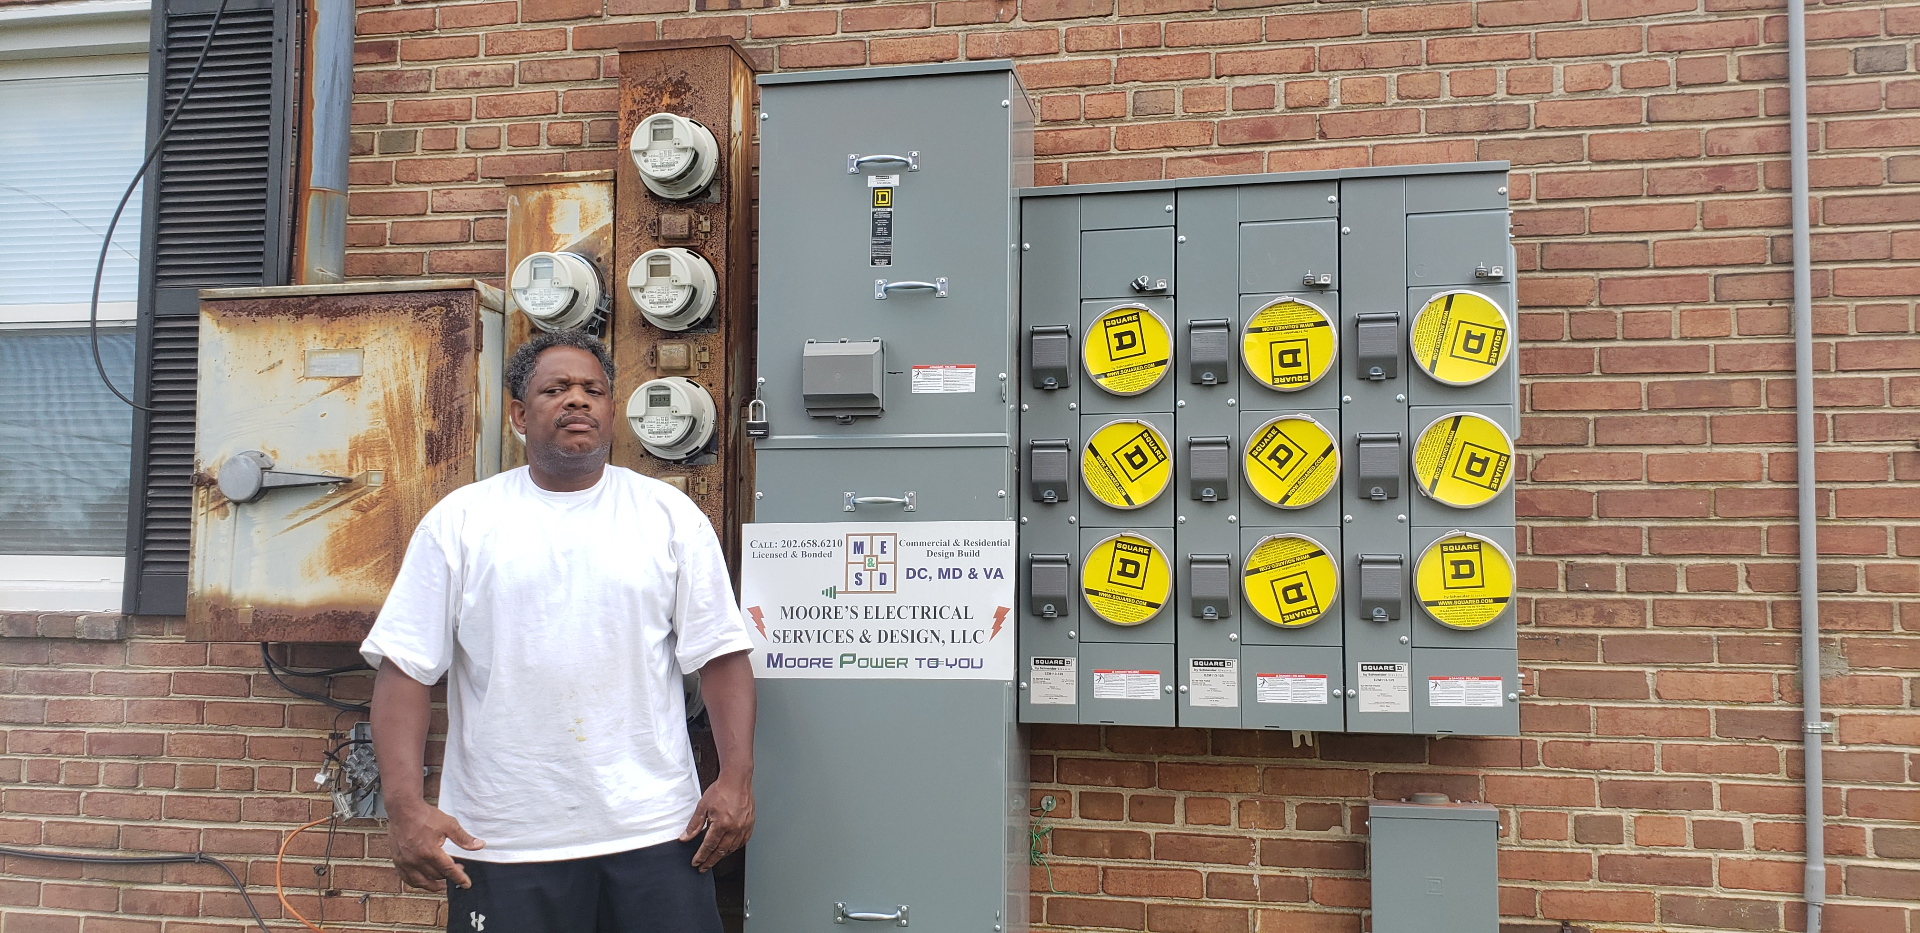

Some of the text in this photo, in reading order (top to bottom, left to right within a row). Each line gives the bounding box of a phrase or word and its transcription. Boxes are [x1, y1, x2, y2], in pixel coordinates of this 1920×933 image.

[877, 192, 888, 203] D
[1105, 315, 1138, 326] SQUARE
[1113, 330, 1137, 351] D
[1463, 330, 1486, 354] D
[1489, 329, 1503, 364] SQUARE
[1278, 348, 1302, 369] D
[1274, 375, 1309, 384] SQUARE
[1142, 432, 1165, 460] SQUARE
[1251, 428, 1278, 456] SQUARE
[1123, 444, 1148, 470] D
[1266, 443, 1294, 470] D
[1465, 451, 1490, 478] D
[1491, 455, 1508, 490] SQUARE
[781, 539, 843, 548] 202.658.6210
[853, 541, 887, 554] M E
[899, 539, 950, 547] Commercial
[1116, 542, 1150, 554] SQUARE
[1442, 544, 1479, 552] SQUARE
[867, 558, 875, 567] &
[926, 549, 980, 559] Design Build
[906, 567, 1004, 581] DC, MD & VA
[1116, 557, 1141, 579] D
[1450, 559, 1476, 580] D
[855, 572, 887, 586] S D
[1282, 582, 1308, 605] D
[780, 605, 974, 620] MOORE'S ELECTRICAL
[1283, 607, 1318, 622] SQUARE
[772, 628, 985, 647] SERVICES & DESIGN, LLC
